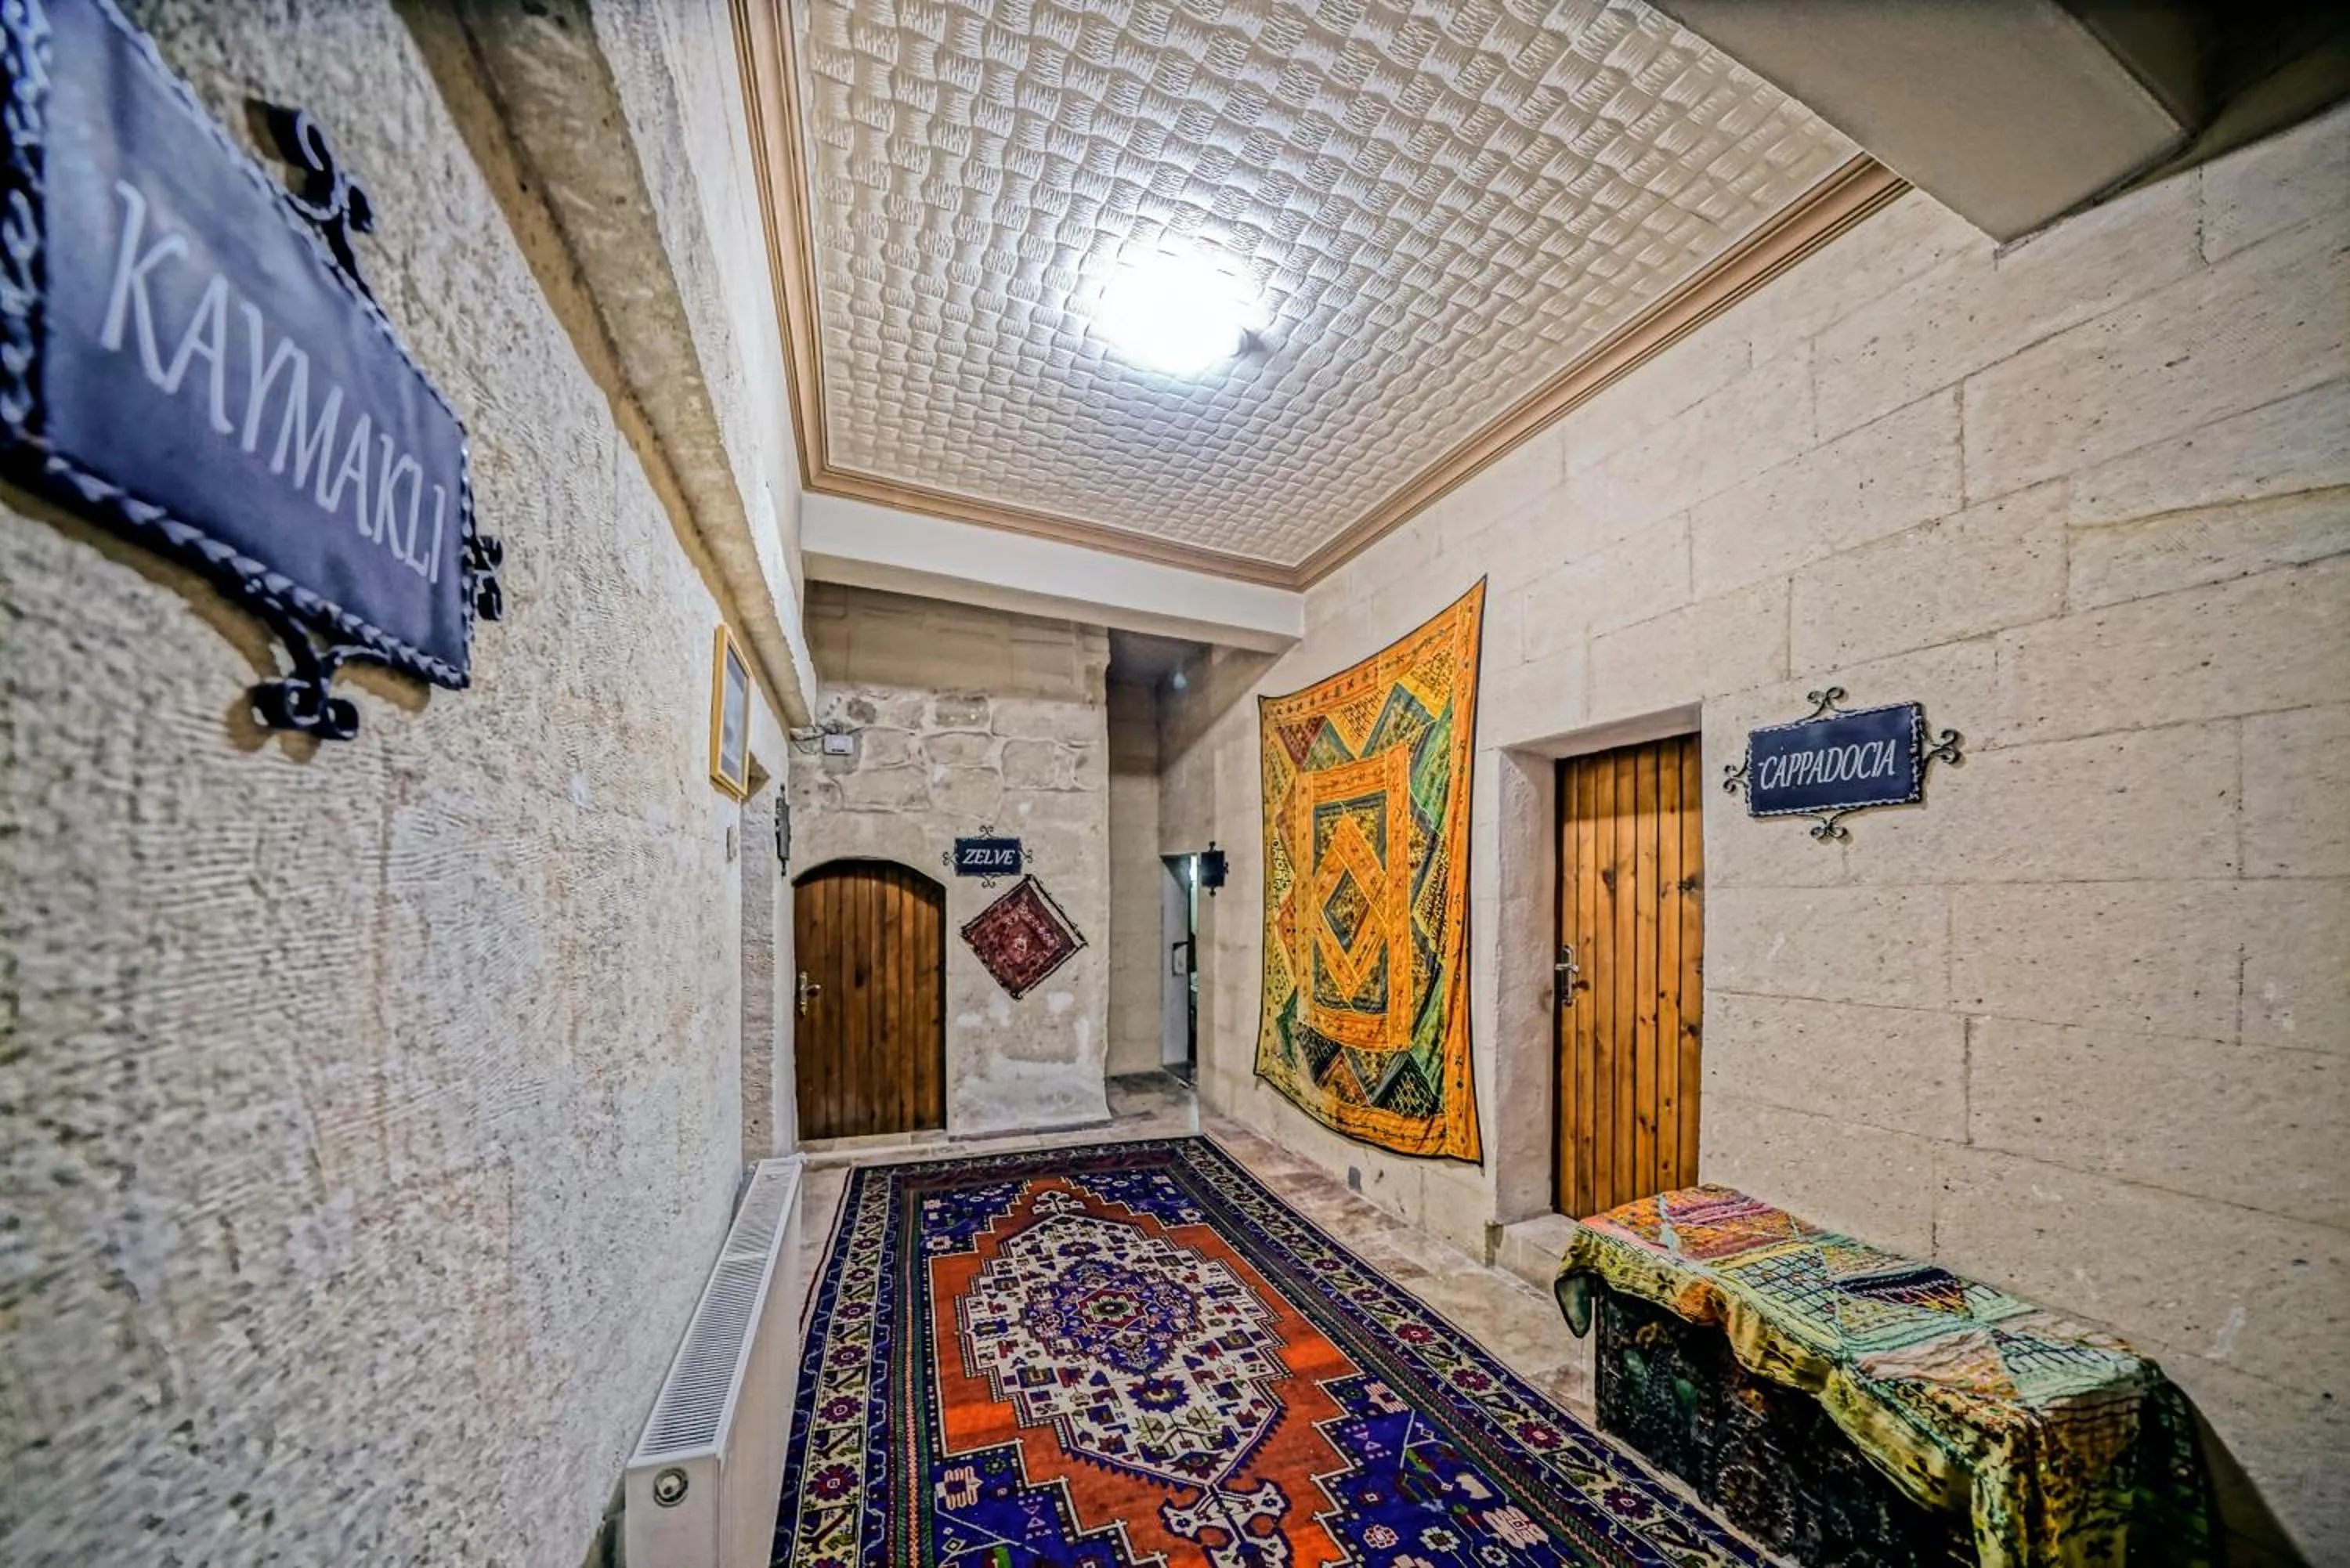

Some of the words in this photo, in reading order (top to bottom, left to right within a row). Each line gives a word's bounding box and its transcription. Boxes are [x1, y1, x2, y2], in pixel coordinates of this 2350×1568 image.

[99, 180, 446, 583] KAYMAKLI
[1761, 739, 1896, 790] CAPPADOCIA
[963, 848, 1014, 865] ZELVE
